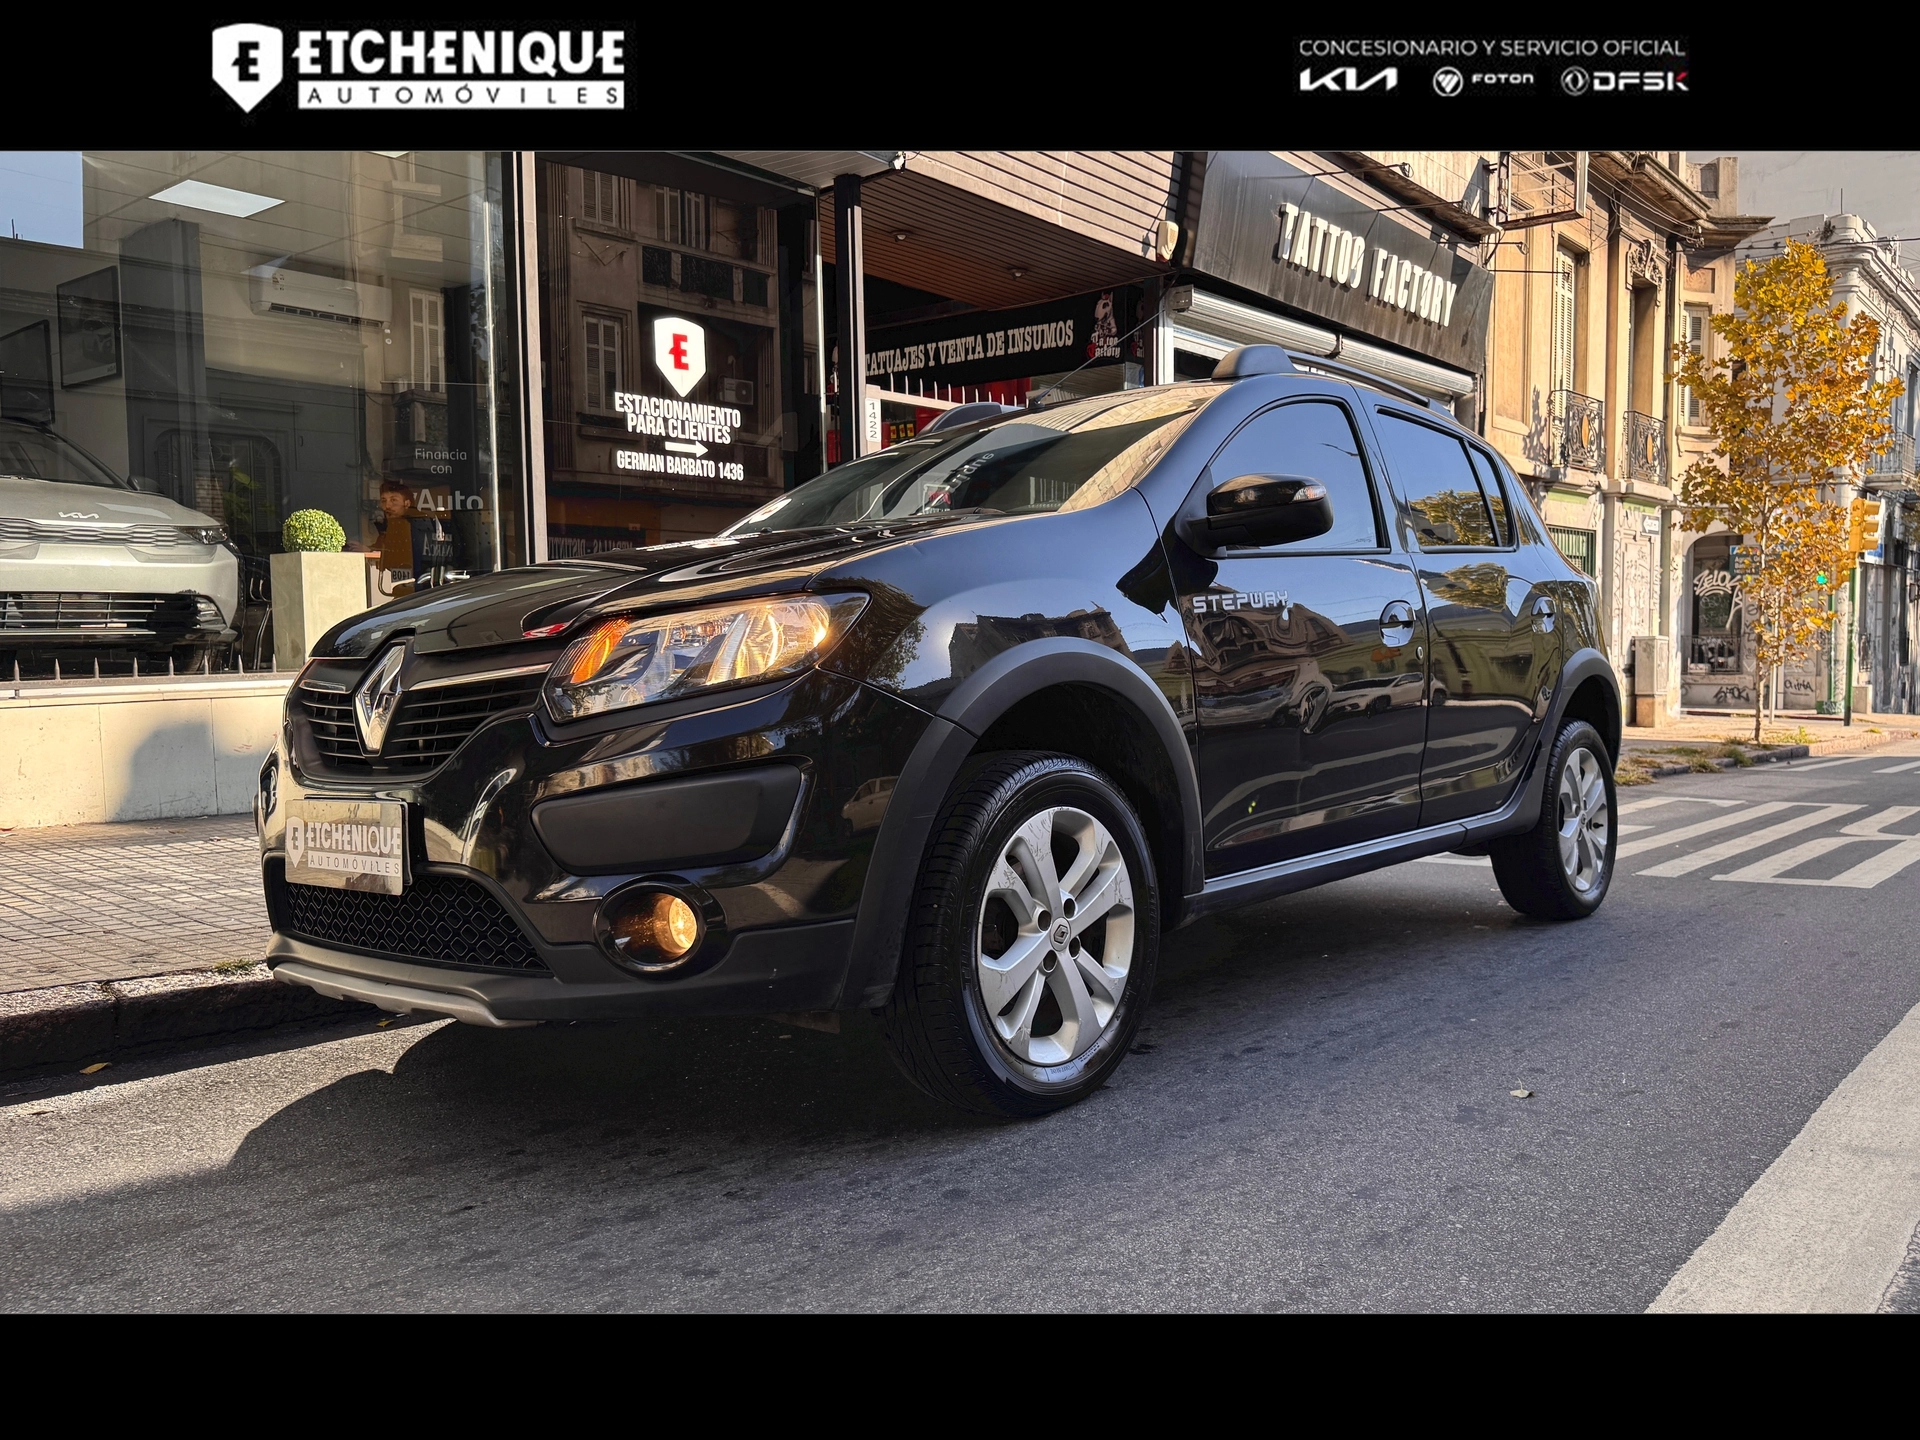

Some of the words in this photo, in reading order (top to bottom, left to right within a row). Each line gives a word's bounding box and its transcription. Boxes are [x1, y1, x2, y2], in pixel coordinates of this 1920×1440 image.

[1279, 203, 1366, 289] TATTOO
[1369, 248, 1457, 328] FACTORY
[865, 343, 925, 376] TATUAJES
[926, 343, 939, 367] Y
[938, 334, 984, 365] VENTA
[986, 332, 1005, 358] DE
[1008, 319, 1074, 354] INSUMOS
[614, 391, 741, 429] ESTACIONAMIENTO
[868, 402, 878, 439] 1422
[627, 412, 666, 437] PARA
[668, 418, 731, 445] CLIENTES
[415, 448, 467, 460] Financia
[430, 465, 453, 474] con
[616, 450, 665, 473] GERMAN
[666, 455, 716, 478] BARBATO
[718, 461, 744, 481] 1436
[1192, 590, 1288, 614] STEPWAY
[306, 822, 401, 855] ETCHENIQUE
[309, 855, 400, 874] AUTOMÓVILES
